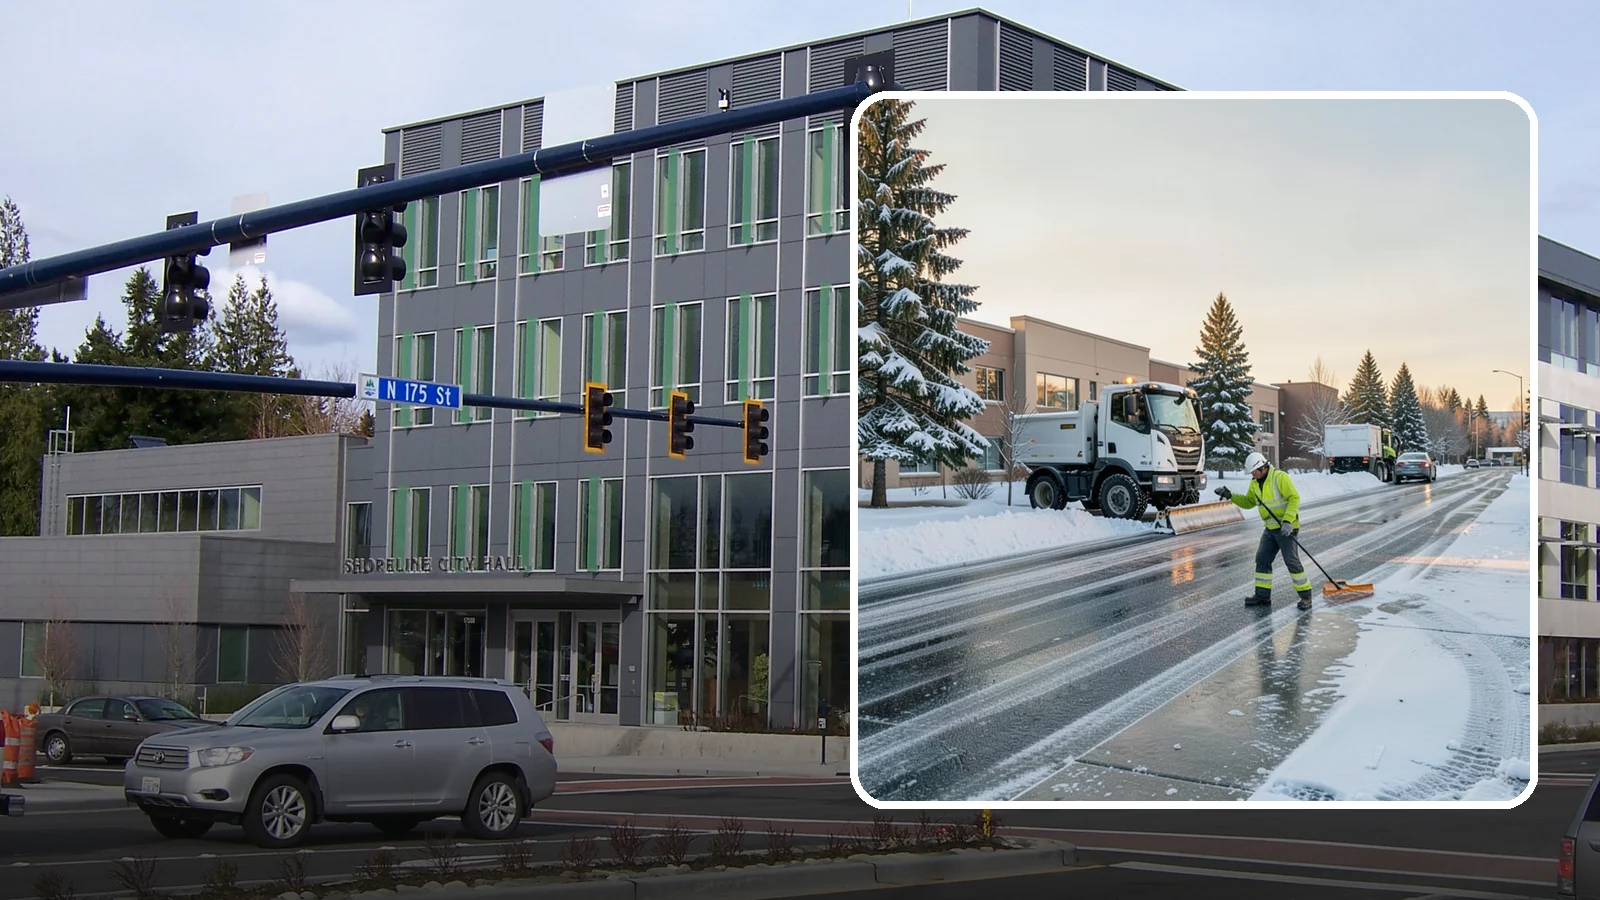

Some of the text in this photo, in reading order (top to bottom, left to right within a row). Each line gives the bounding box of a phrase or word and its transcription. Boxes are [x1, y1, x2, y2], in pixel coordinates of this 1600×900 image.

[387, 380, 451, 406] N 175 St
[344, 556, 526, 574] SHORELINE CITY HALL
